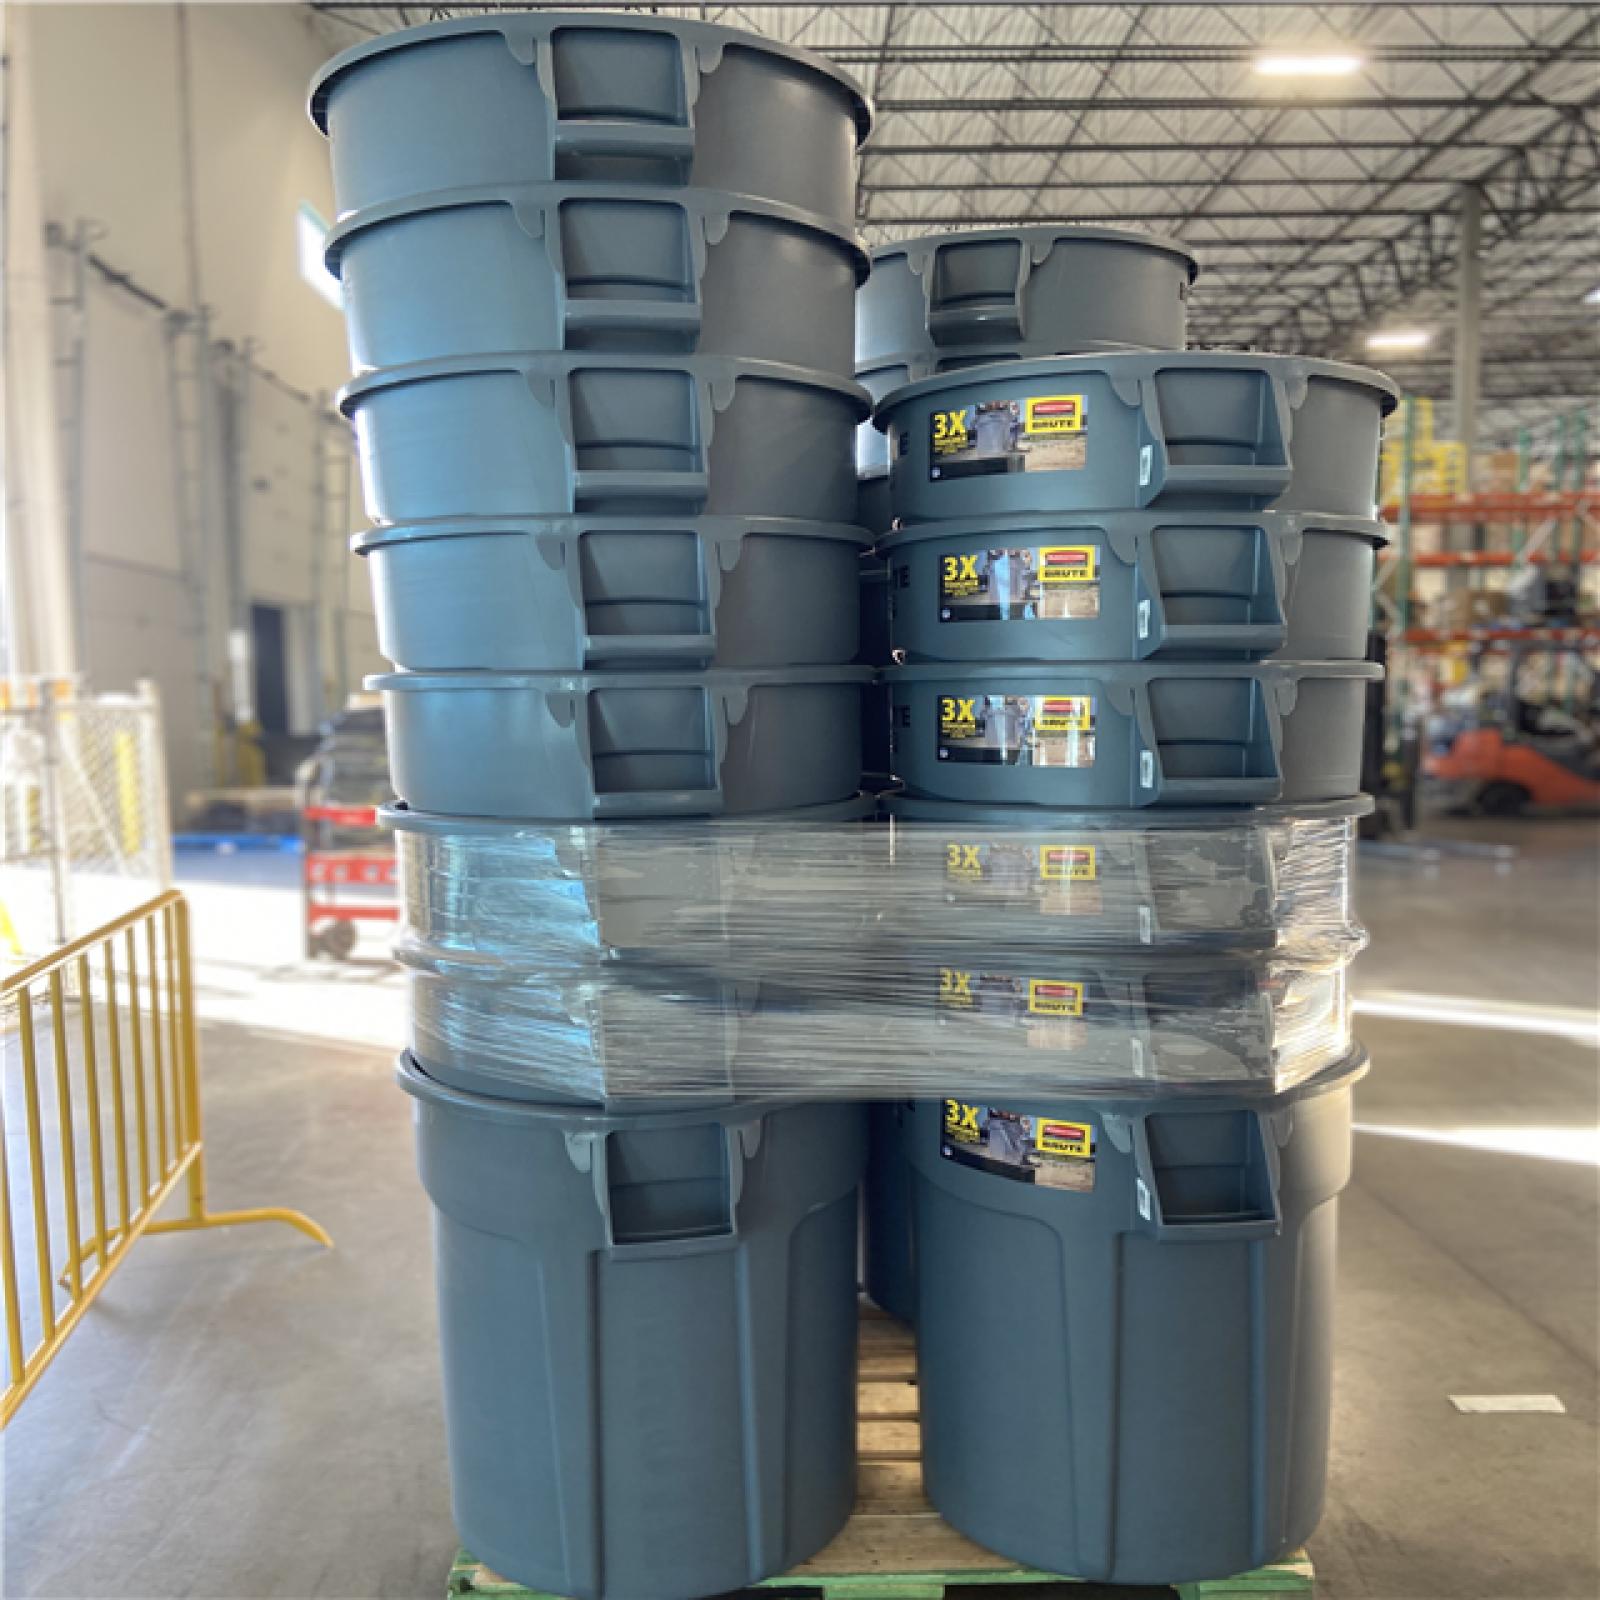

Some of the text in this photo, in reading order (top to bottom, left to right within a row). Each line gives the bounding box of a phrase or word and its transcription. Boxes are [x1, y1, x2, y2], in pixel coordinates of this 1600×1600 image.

[934, 410, 967, 438] 3X
[1032, 419, 1074, 429] BRUTE
[944, 555, 978, 581] 3X
[1044, 569, 1086, 578] BRUTE
[942, 698, 975, 721] 3X
[947, 844, 981, 869] 3X
[940, 968, 972, 994] 3X
[945, 1098, 979, 1129] 3X
[1042, 1141, 1082, 1152] BRUTE
